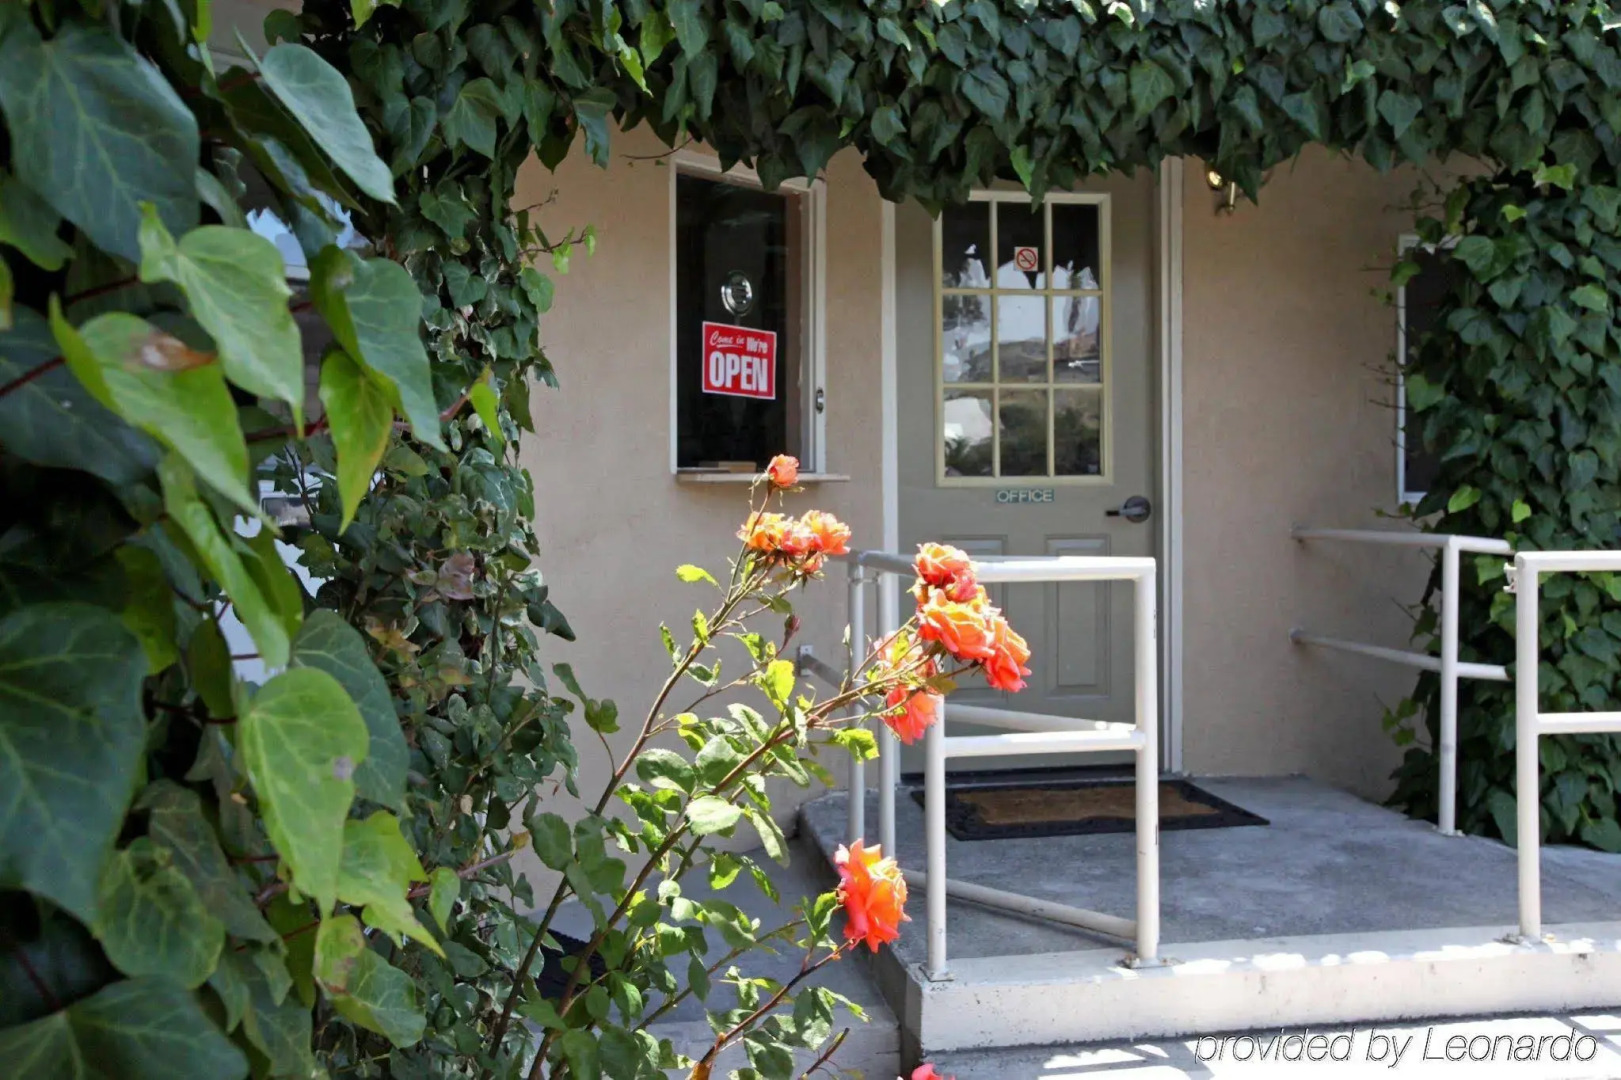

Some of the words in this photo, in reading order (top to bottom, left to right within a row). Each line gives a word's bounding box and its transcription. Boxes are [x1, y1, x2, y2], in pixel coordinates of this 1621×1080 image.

[709, 330, 734, 346] Come
[736, 334, 745, 345] in
[709, 351, 768, 392] OPEN
[997, 489, 1053, 502] OFFICE
